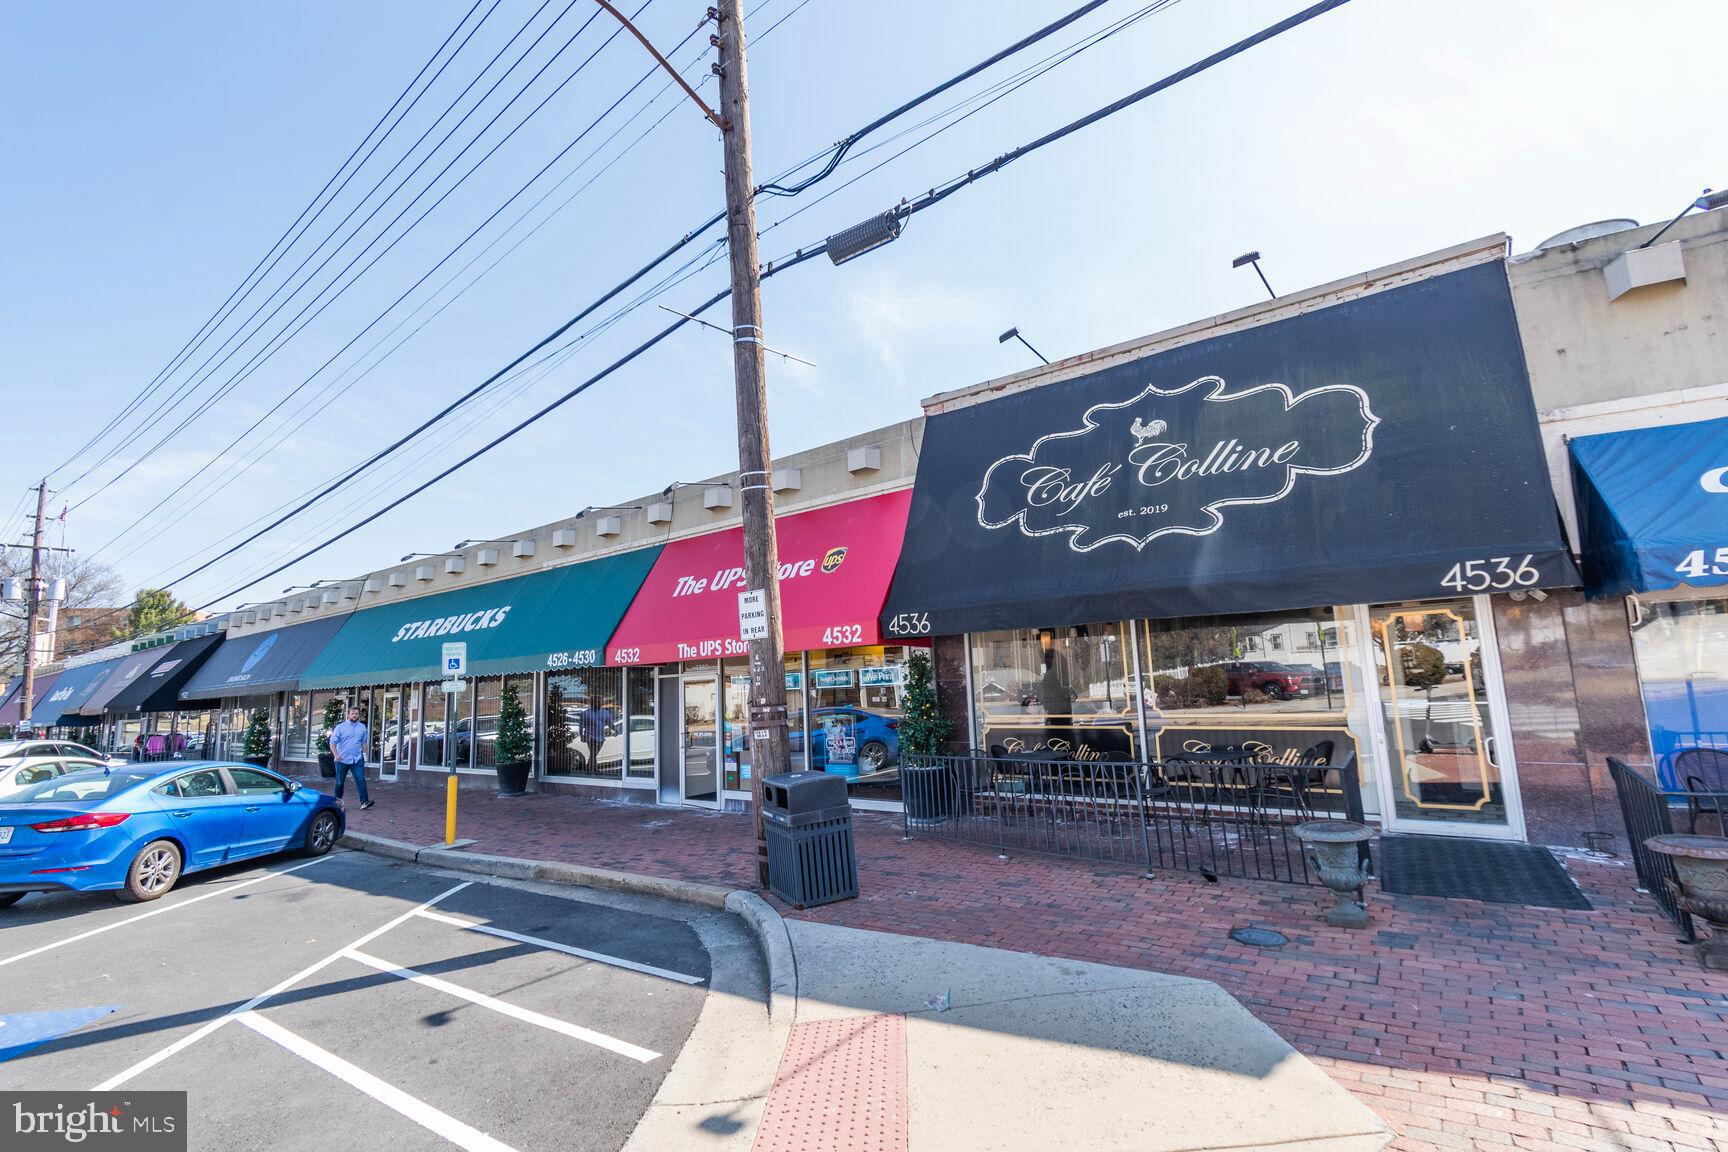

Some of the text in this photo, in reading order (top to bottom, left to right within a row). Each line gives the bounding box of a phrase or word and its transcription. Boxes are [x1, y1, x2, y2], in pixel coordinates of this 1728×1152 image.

[1021, 438, 1300, 516] Café Colline
[1117, 503, 1168, 519] est. 2019
[824, 553, 844, 570] ups
[1440, 554, 1540, 592] 4536
[672, 575, 707, 597] The
[744, 595, 759, 604] MORE
[392, 605, 511, 643] STARBUCKS
[741, 610, 765, 620] PARKING
[888, 612, 931, 635] 4536
[742, 625, 765, 635] IN REAR
[823, 624, 863, 645] 4532
[614, 648, 640, 663] 4532
[678, 634, 750, 658] The UPS Stor
[547, 650, 596, 667] 4526-4530
